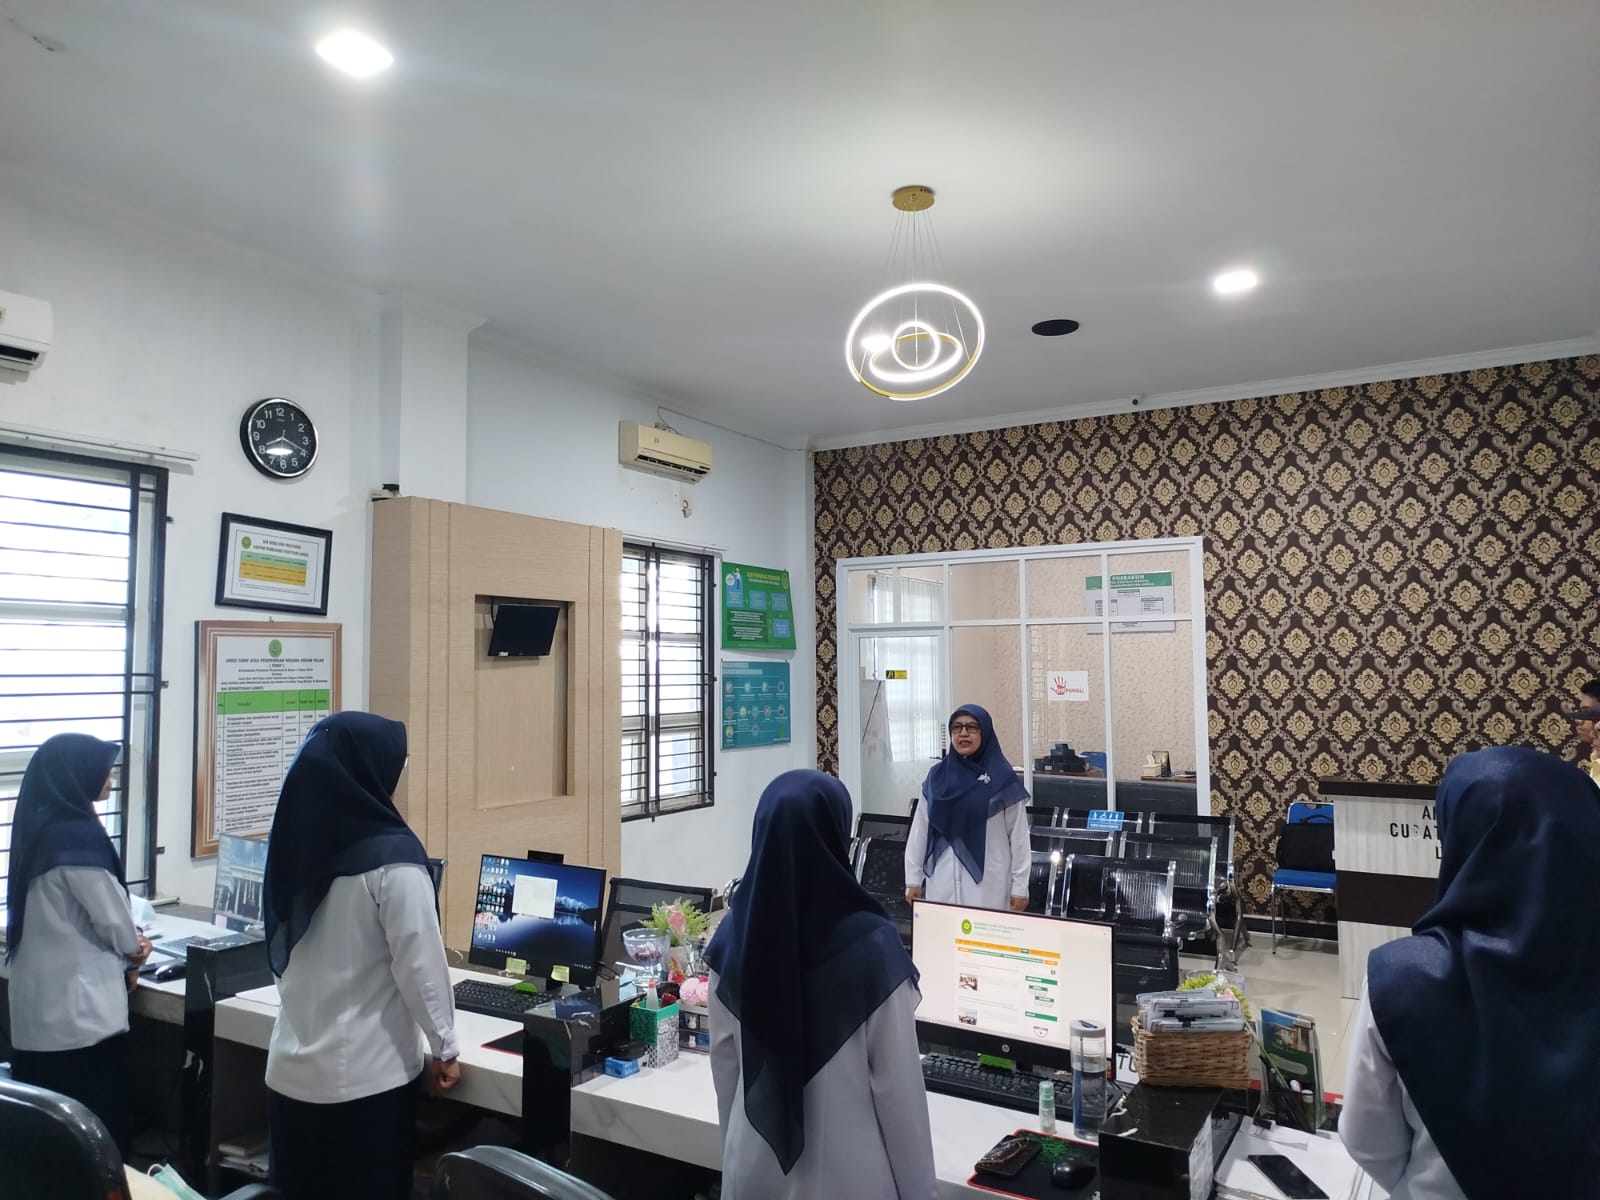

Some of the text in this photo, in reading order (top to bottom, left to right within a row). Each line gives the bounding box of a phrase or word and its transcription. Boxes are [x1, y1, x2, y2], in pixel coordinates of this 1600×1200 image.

[264, 410, 273, 419] 11
[276, 407, 285, 417] 12
[290, 413, 295, 422] 1
[256, 420, 266, 429] 10
[298, 424, 305, 433] 2
[253, 431, 260, 441] 9
[302, 436, 309, 446] 3
[259, 445, 266, 454] 8
[269, 456, 275, 465] 7
[280, 459, 287, 469] 6
[291, 457, 298, 467] 5
